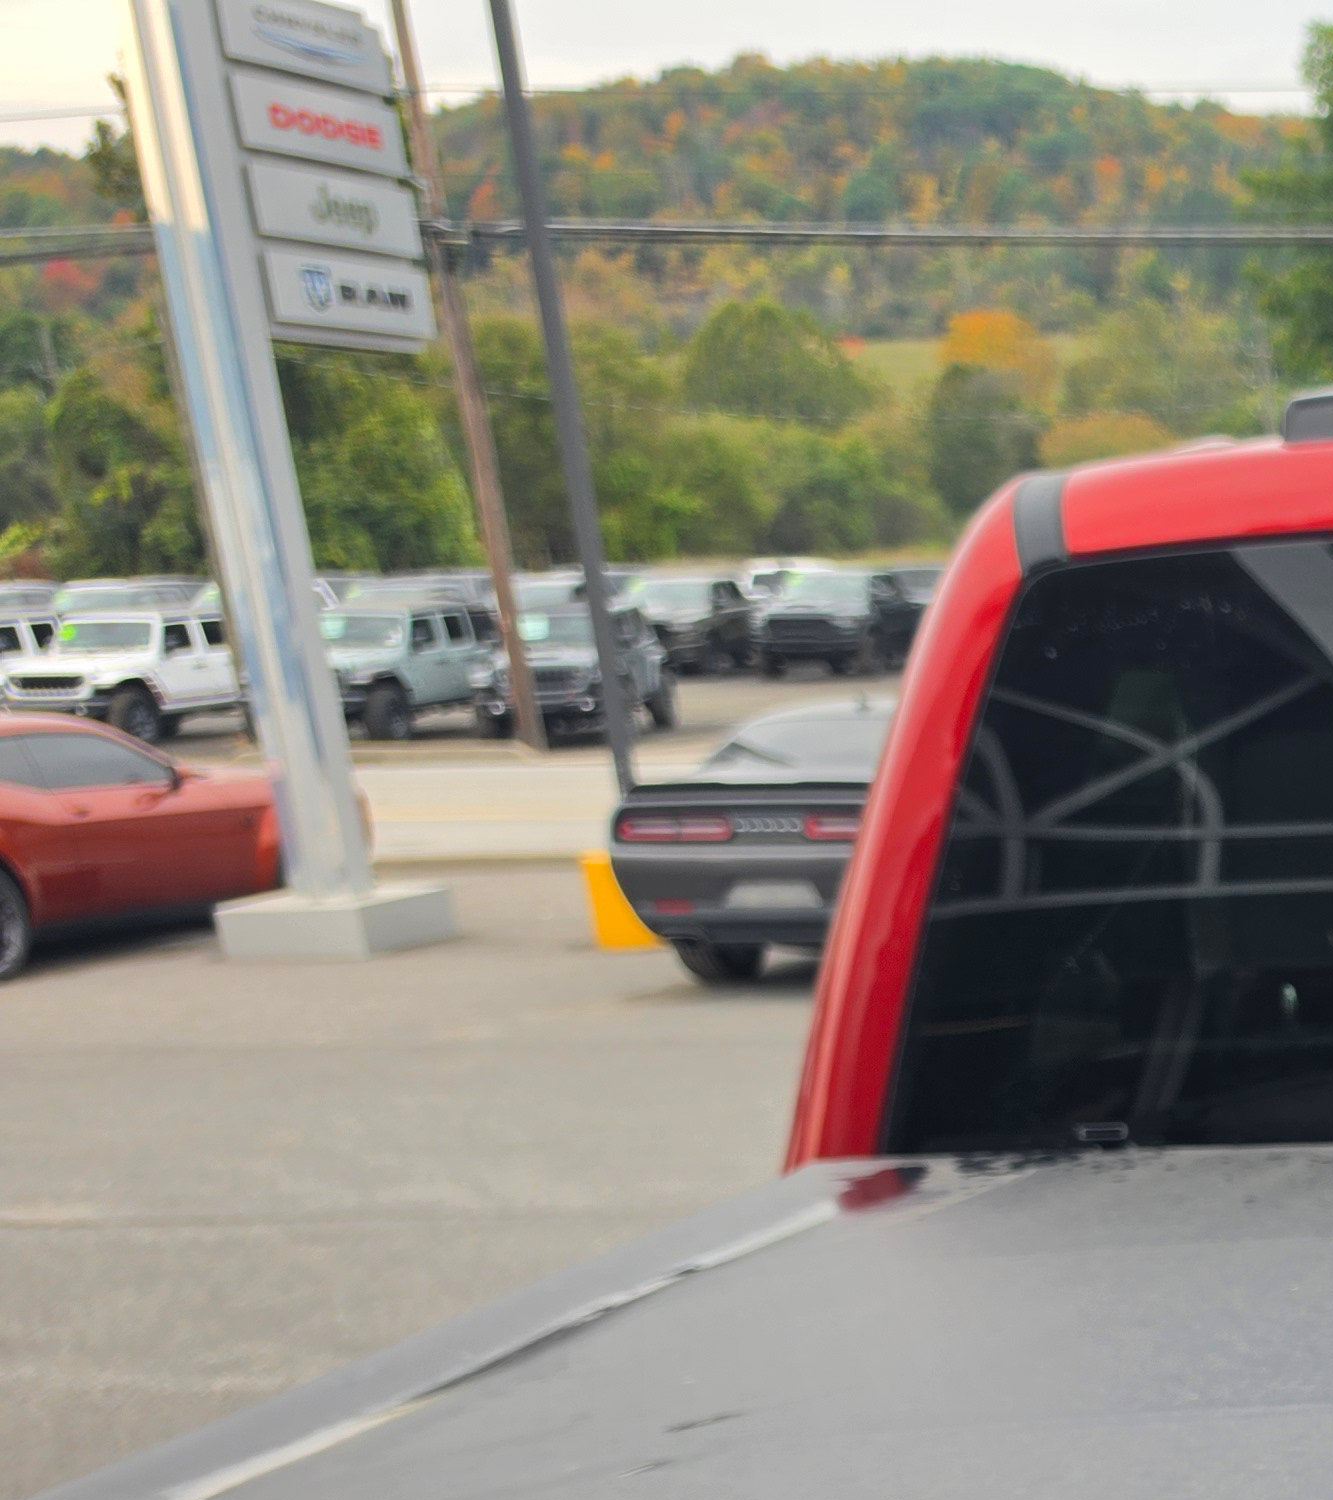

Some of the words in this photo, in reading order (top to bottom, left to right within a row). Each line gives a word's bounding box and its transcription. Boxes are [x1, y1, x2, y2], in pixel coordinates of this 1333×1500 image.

[269, 103, 383, 151] DODGE
[312, 181, 379, 235] Jeep
[339, 284, 410, 309] RAM
